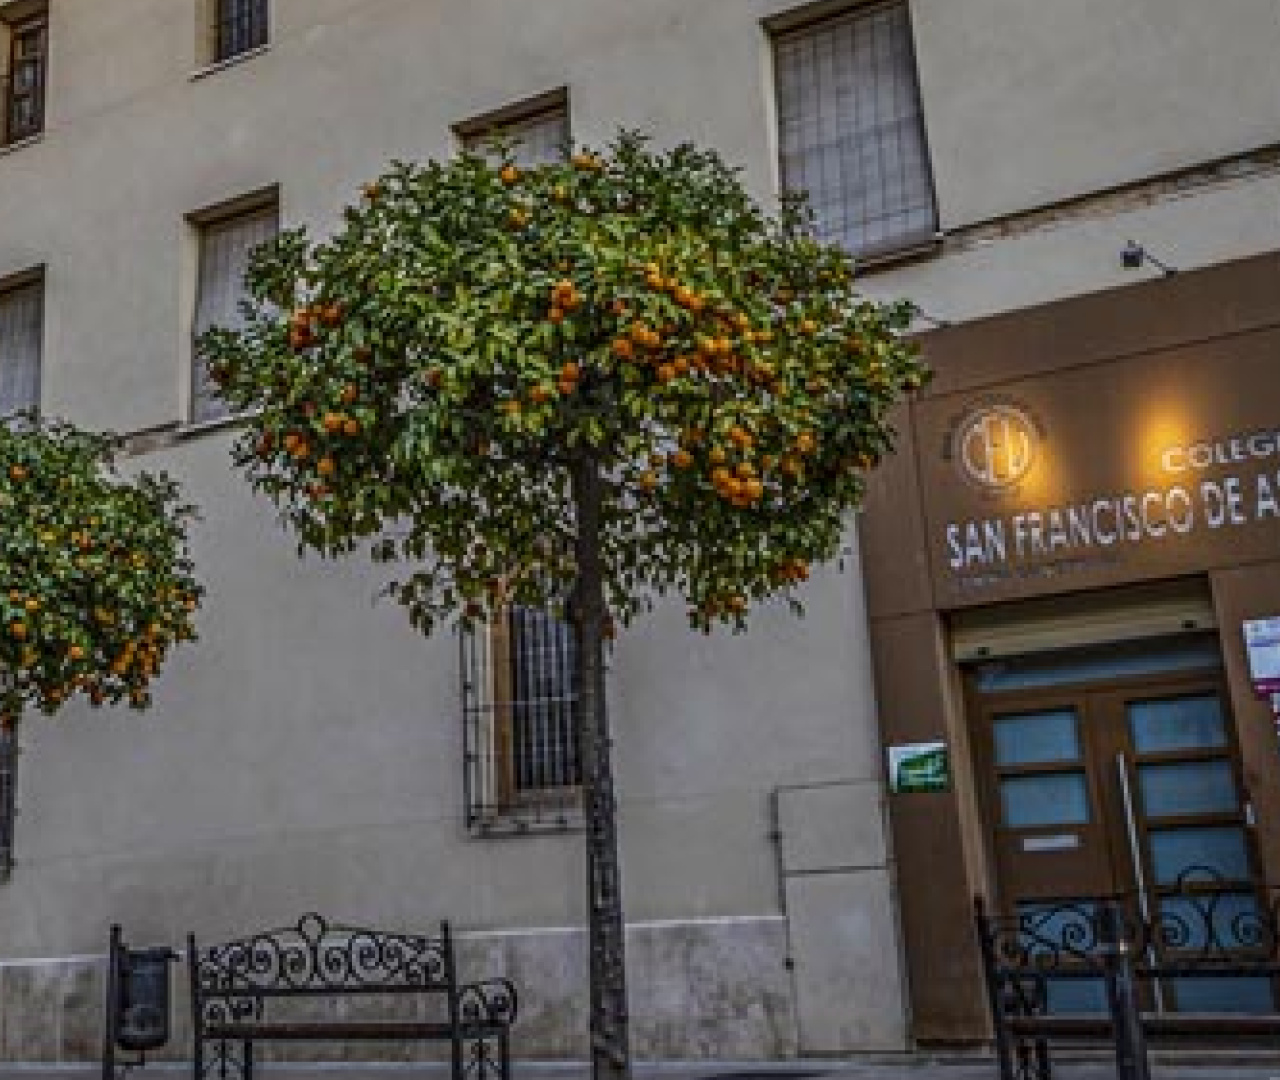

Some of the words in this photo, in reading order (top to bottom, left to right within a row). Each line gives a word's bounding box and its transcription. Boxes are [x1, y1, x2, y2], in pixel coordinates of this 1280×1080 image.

[946, 519, 1007, 570] SAN
[1013, 486, 1194, 557] FRANCISCO
[1200, 477, 1247, 528] DE
